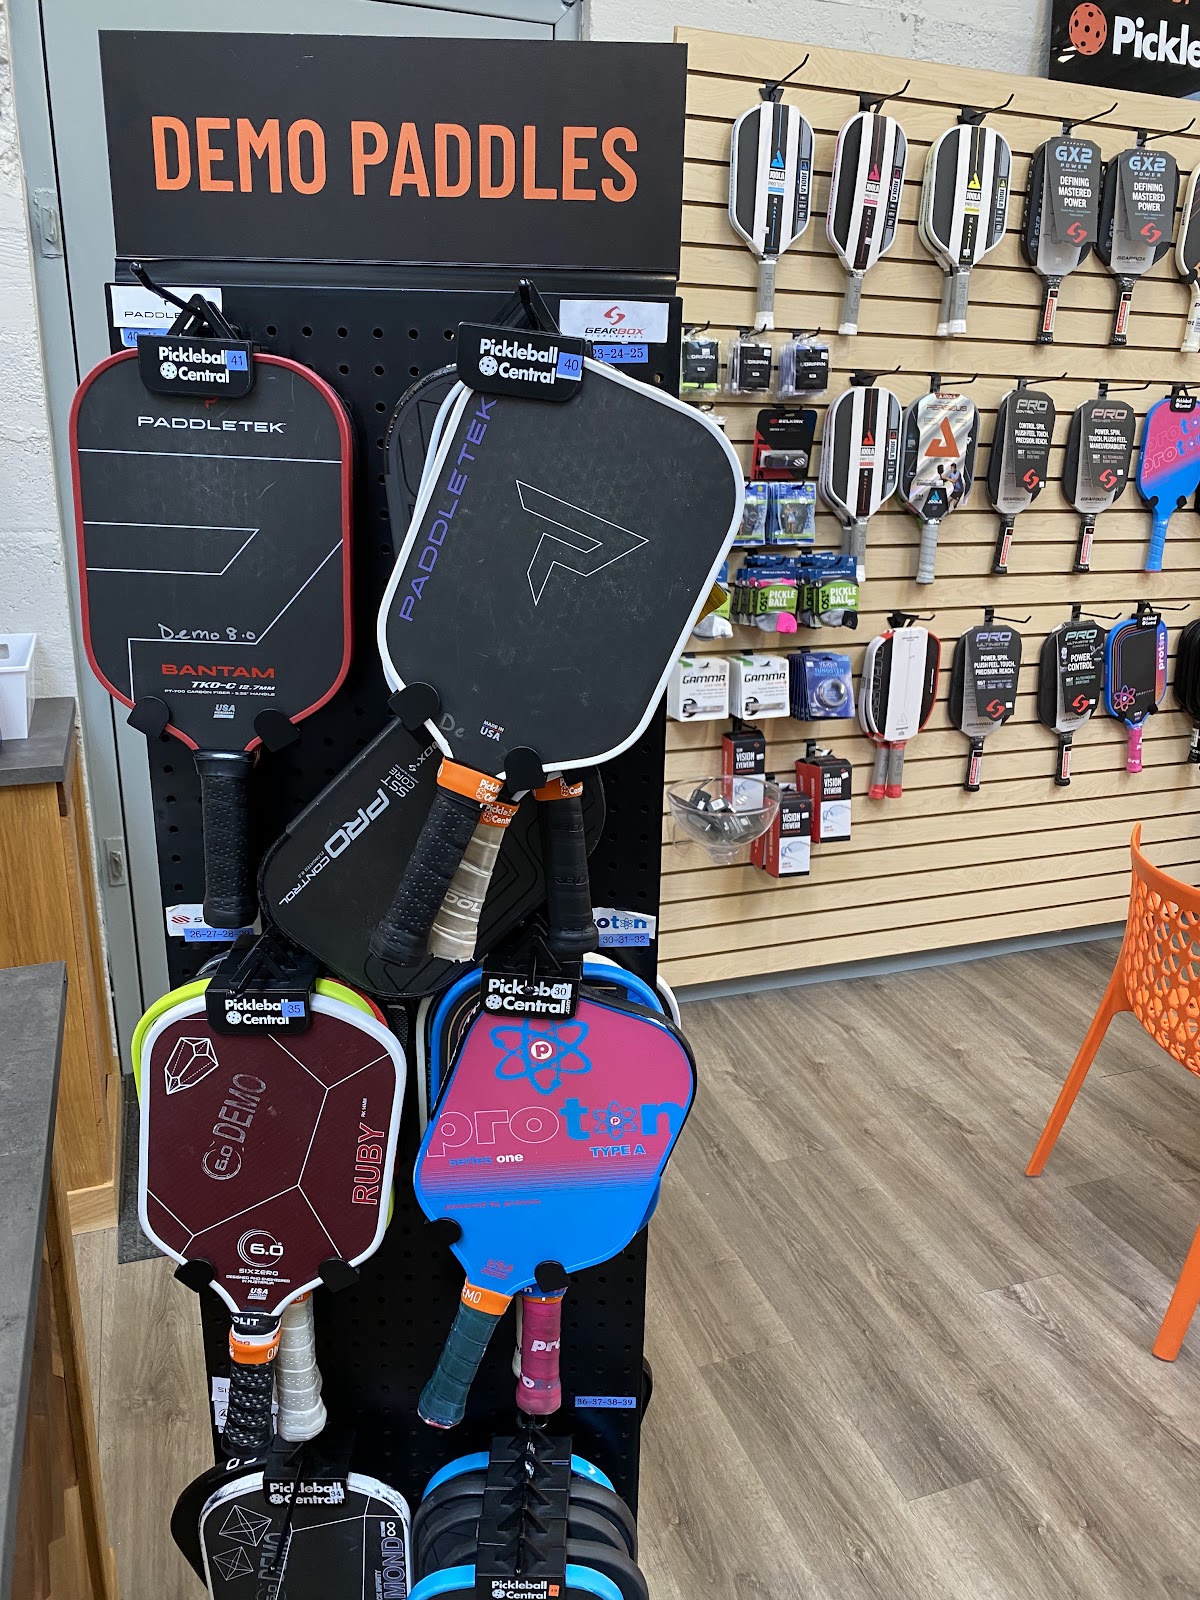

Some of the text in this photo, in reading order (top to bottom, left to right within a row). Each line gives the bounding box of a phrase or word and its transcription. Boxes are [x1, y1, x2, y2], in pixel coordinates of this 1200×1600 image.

[151, 116, 638, 203] DEMO PADDLES
[1055, 146, 1092, 164] GX2
[1129, 156, 1166, 172] GX2
[1060, 176, 1090, 187] DEFINING
[1058, 186, 1092, 198] MASTERED
[1134, 182, 1163, 192] DEFINING
[1132, 192, 1166, 202] MASTERED
[1064, 198, 1086, 208] POWER
[1138, 202, 1160, 212] POWER
[585, 327, 644, 335] GEARBOX
[480, 338, 559, 364] Pickleball
[231, 356, 243, 366] 41
[564, 358, 579, 372] 40
[178, 366, 230, 384] Central
[498, 362, 556, 384] Central
[1017, 399, 1048, 410] PRO
[1091, 408, 1127, 420] PRO
[137, 416, 286, 434] PADDLETEK
[399, 395, 497, 622] PADDLETEK
[769, 590, 796, 600] PICKLE
[830, 587, 857, 596] PICKLE
[768, 599, 787, 607] BALL
[830, 596, 848, 604] BALL
[158, 622, 256, 640] Demo 8.0
[1065, 630, 1097, 641] PRO
[976, 632, 1012, 642] PRO
[1070, 653, 1092, 662] POWER.
[1068, 661, 1095, 671] CONTROL.
[162, 664, 274, 679] BANTAM
[682, 675, 726, 684] GAMMA
[744, 673, 785, 682] GAMMA
[190, 681, 236, 690] TKO-C
[215, 704, 236, 712] USA
[480, 726, 500, 741] USA
[736, 752, 755, 761] VISION
[389, 767, 415, 789] CORE
[824, 778, 842, 787] VISION
[381, 776, 409, 797] SST
[824, 787, 842, 795] EYEWEAR
[783, 813, 800, 822] VISION
[324, 788, 390, 858] PRO
[782, 822, 800, 830] EYEWEAR
[279, 856, 330, 905] CONTROL
[602, 934, 646, 944] 30-31-32
[554, 988, 567, 996] 30
[288, 1005, 300, 1013] 35
[503, 996, 564, 1014] Central
[243, 1014, 289, 1024] Central
[212, 1074, 266, 1144] DEMO
[590, 1144, 646, 1158] TYPE A
[352, 1122, 385, 1205] RUBY
[449, 1154, 524, 1166] series one
[250, 1243, 284, 1256] 6.0
[488, 1259, 514, 1272] USA
[238, 1268, 278, 1276] SIXZERO
[577, 1398, 633, 1406] 36-37-38-39
[491, 1580, 548, 1589] Pickleball
[506, 1591, 547, 1599] Central
